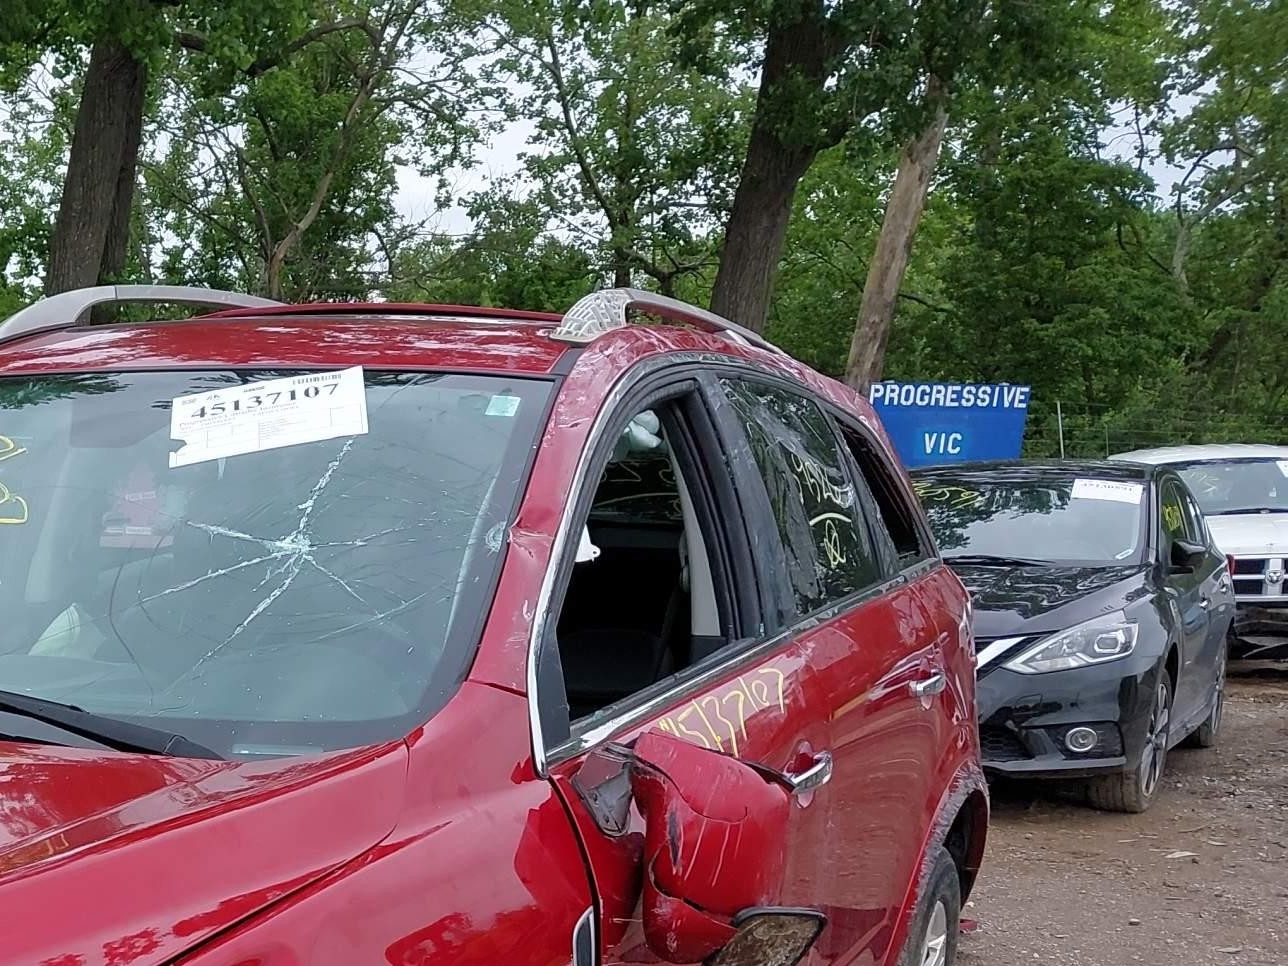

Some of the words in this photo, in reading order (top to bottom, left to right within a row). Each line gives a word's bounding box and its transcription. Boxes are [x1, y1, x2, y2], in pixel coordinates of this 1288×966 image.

[190, 383, 340, 418] 45137107
[869, 384, 1031, 408] PROGRESSIVE
[924, 432, 964, 455] VIC
